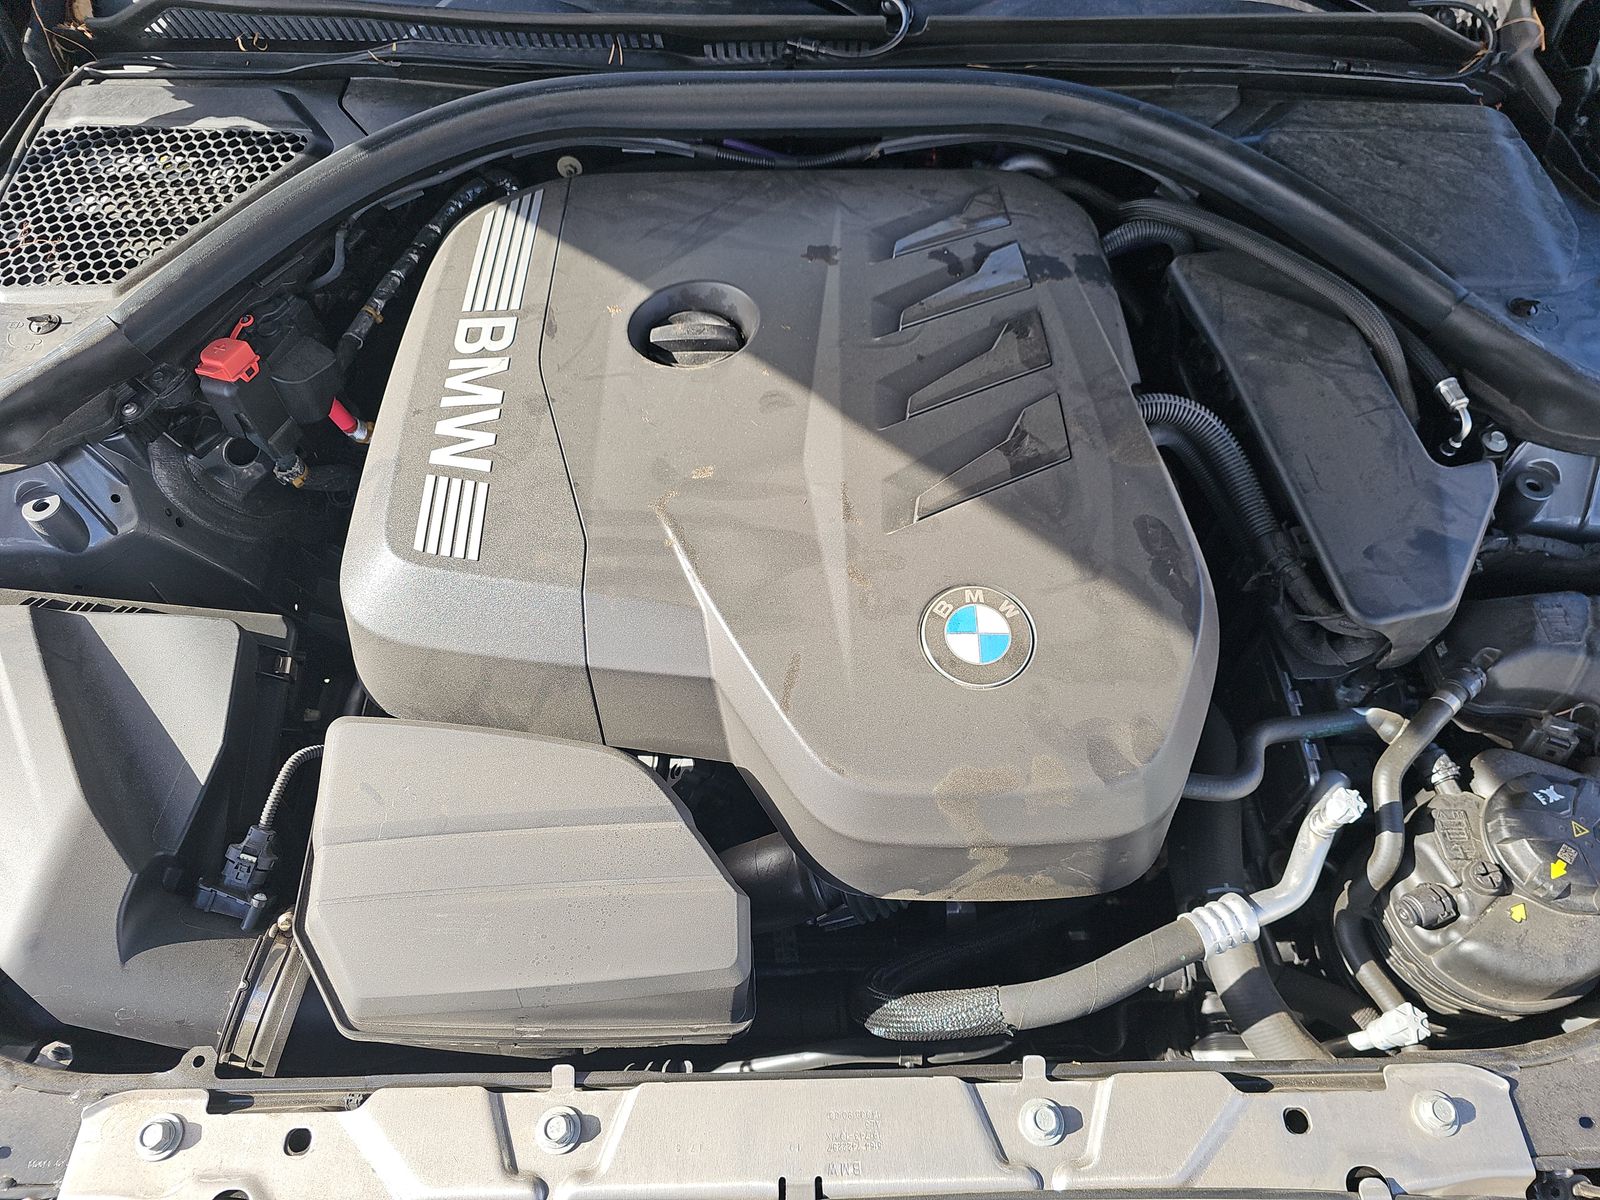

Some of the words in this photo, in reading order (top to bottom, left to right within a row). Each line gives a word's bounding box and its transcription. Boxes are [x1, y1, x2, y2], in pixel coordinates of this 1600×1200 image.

[428, 316, 518, 473] BMW
[933, 589, 1020, 619] BMW
[827, 1161, 861, 1176] BMW
